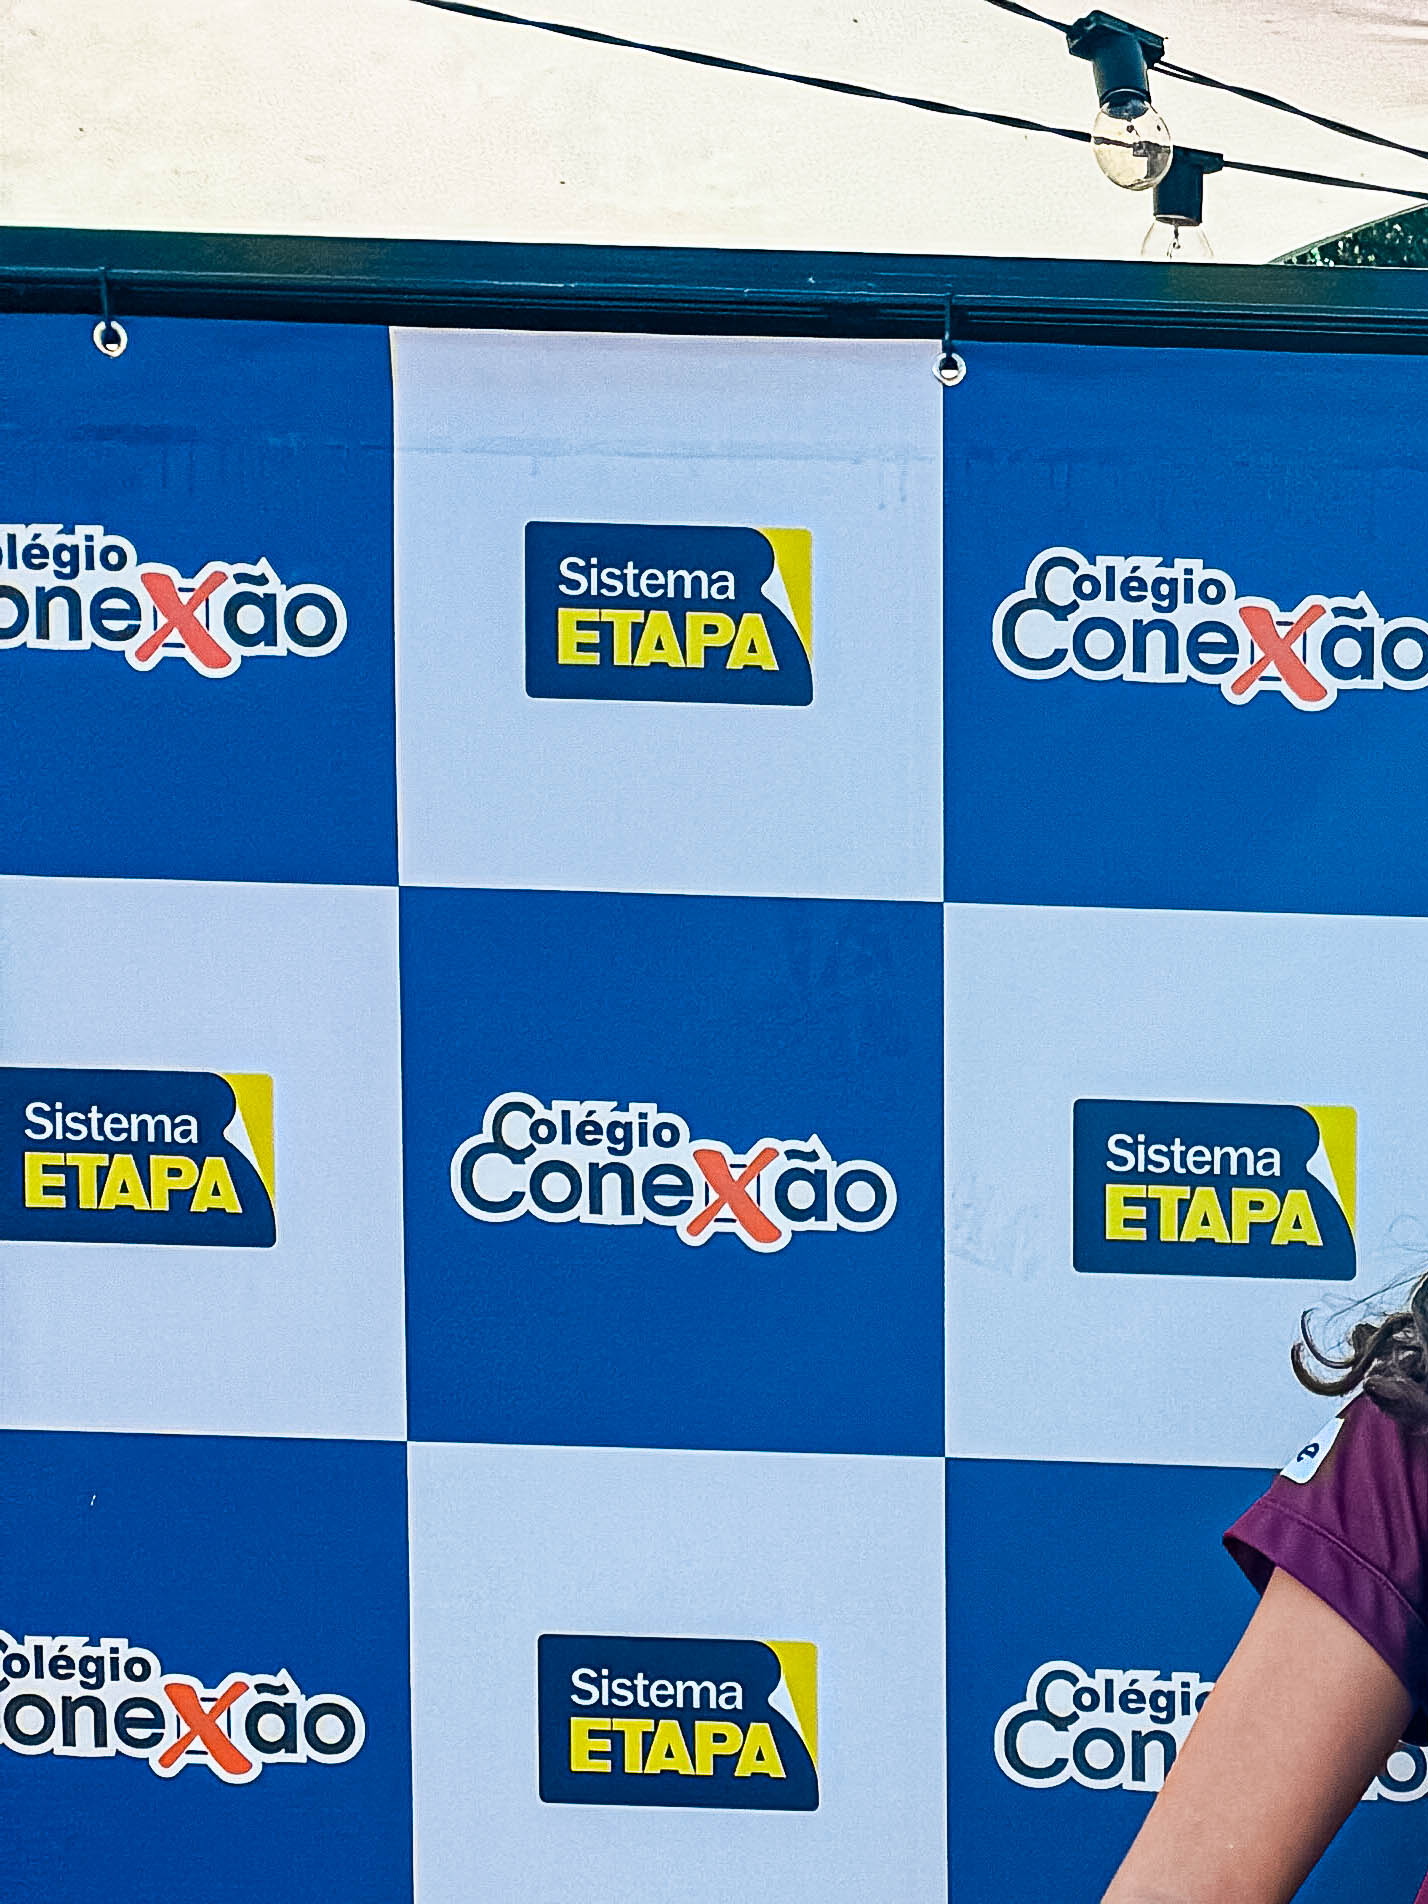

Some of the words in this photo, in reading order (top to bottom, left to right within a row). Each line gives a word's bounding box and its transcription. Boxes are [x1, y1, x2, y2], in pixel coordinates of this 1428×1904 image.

[0, 533, 128, 580] légio
[558, 556, 736, 600] Sistema
[1035, 557, 1227, 613] Colégio
[0, 571, 338, 668] oneXão
[558, 607, 779, 671] ETAPA
[23, 1101, 198, 1144] Sistema
[492, 1101, 681, 1157] Colégio
[23, 1151, 243, 1214] ETAPA
[1105, 1133, 1281, 1176] Sistema
[1104, 1183, 1323, 1246] ETAPA
[0, 1645, 152, 1690] olégio
[570, 1667, 743, 1710] Sistema
[1035, 1669, 1213, 1725] Colégi
[0, 1681, 356, 1775] oneXão
[570, 1716, 786, 1779] ETAPA
